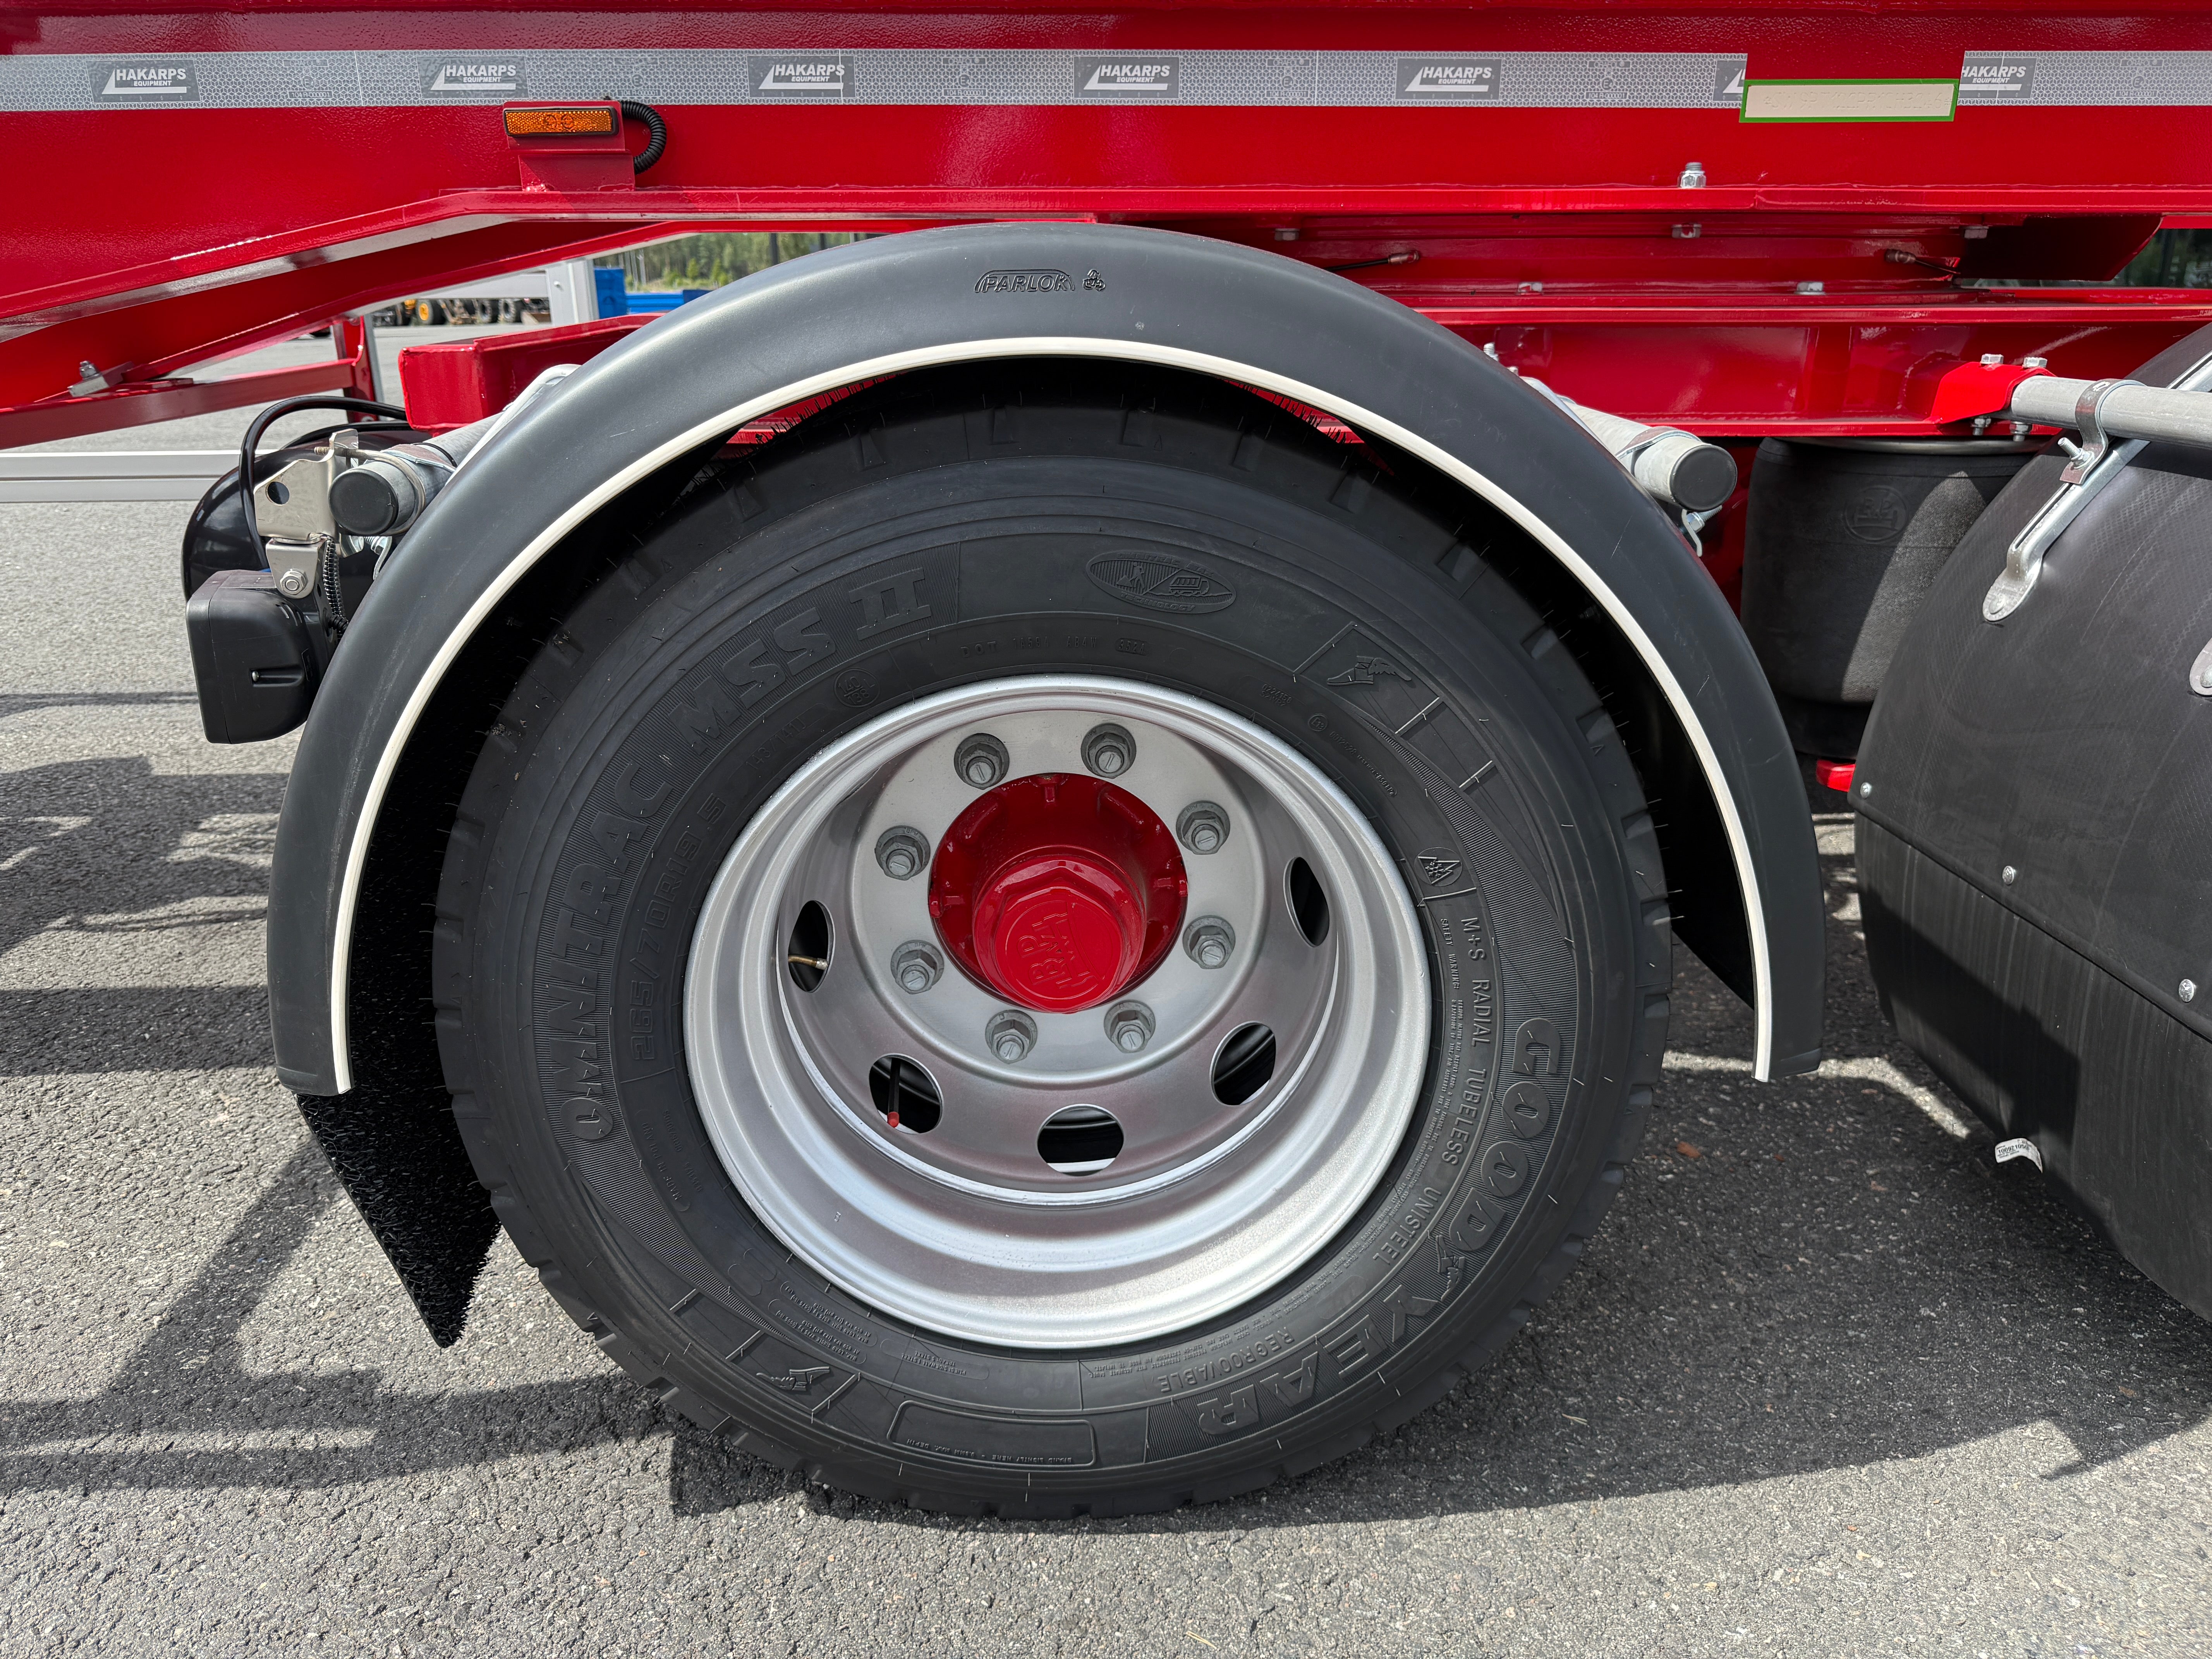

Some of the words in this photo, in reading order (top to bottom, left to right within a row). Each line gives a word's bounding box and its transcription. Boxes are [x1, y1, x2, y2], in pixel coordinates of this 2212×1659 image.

[116, 68, 186, 80] HAKARPS
[446, 65, 516, 76] HAKARPS
[775, 64, 845, 76] HAKARPS
[1100, 65, 1170, 77] HAKARPS
[1423, 67, 1492, 78] HAKARPS
[1961, 66, 2026, 77] HAKARPS
[982, 275, 1068, 292] PARLOK
[960, 640, 998, 659] DOT
[1066, 635, 1097, 648] AB4W
[1118, 639, 1145, 654] 3524
[839, 677, 860, 693] 140
[848, 690, 869, 704] 138
[745, 718, 807, 771] 143/141J
[548, 763, 672, 1140] OMNITRAC
[668, 607, 837, 756] MSS
[849, 567, 931, 641] II
[632, 792, 727, 1060] 265/70R19.5
[1461, 917, 1486, 961] M+S
[1441, 919, 1453, 946] SAFETY
[1449, 954, 1459, 989] WARNING:
[1472, 980, 1492, 1048] RADIAL
[1441, 1069, 1486, 1166] TUBELESS
[656, 1161, 669, 1172] IN
[661, 1175, 683, 1200] MADE
[1199, 1018, 1562, 1435] GOODYEAR
[1372, 1187, 1442, 1265] UNISTEEL
[1160, 1329, 1294, 1393] REGROOVABLE
